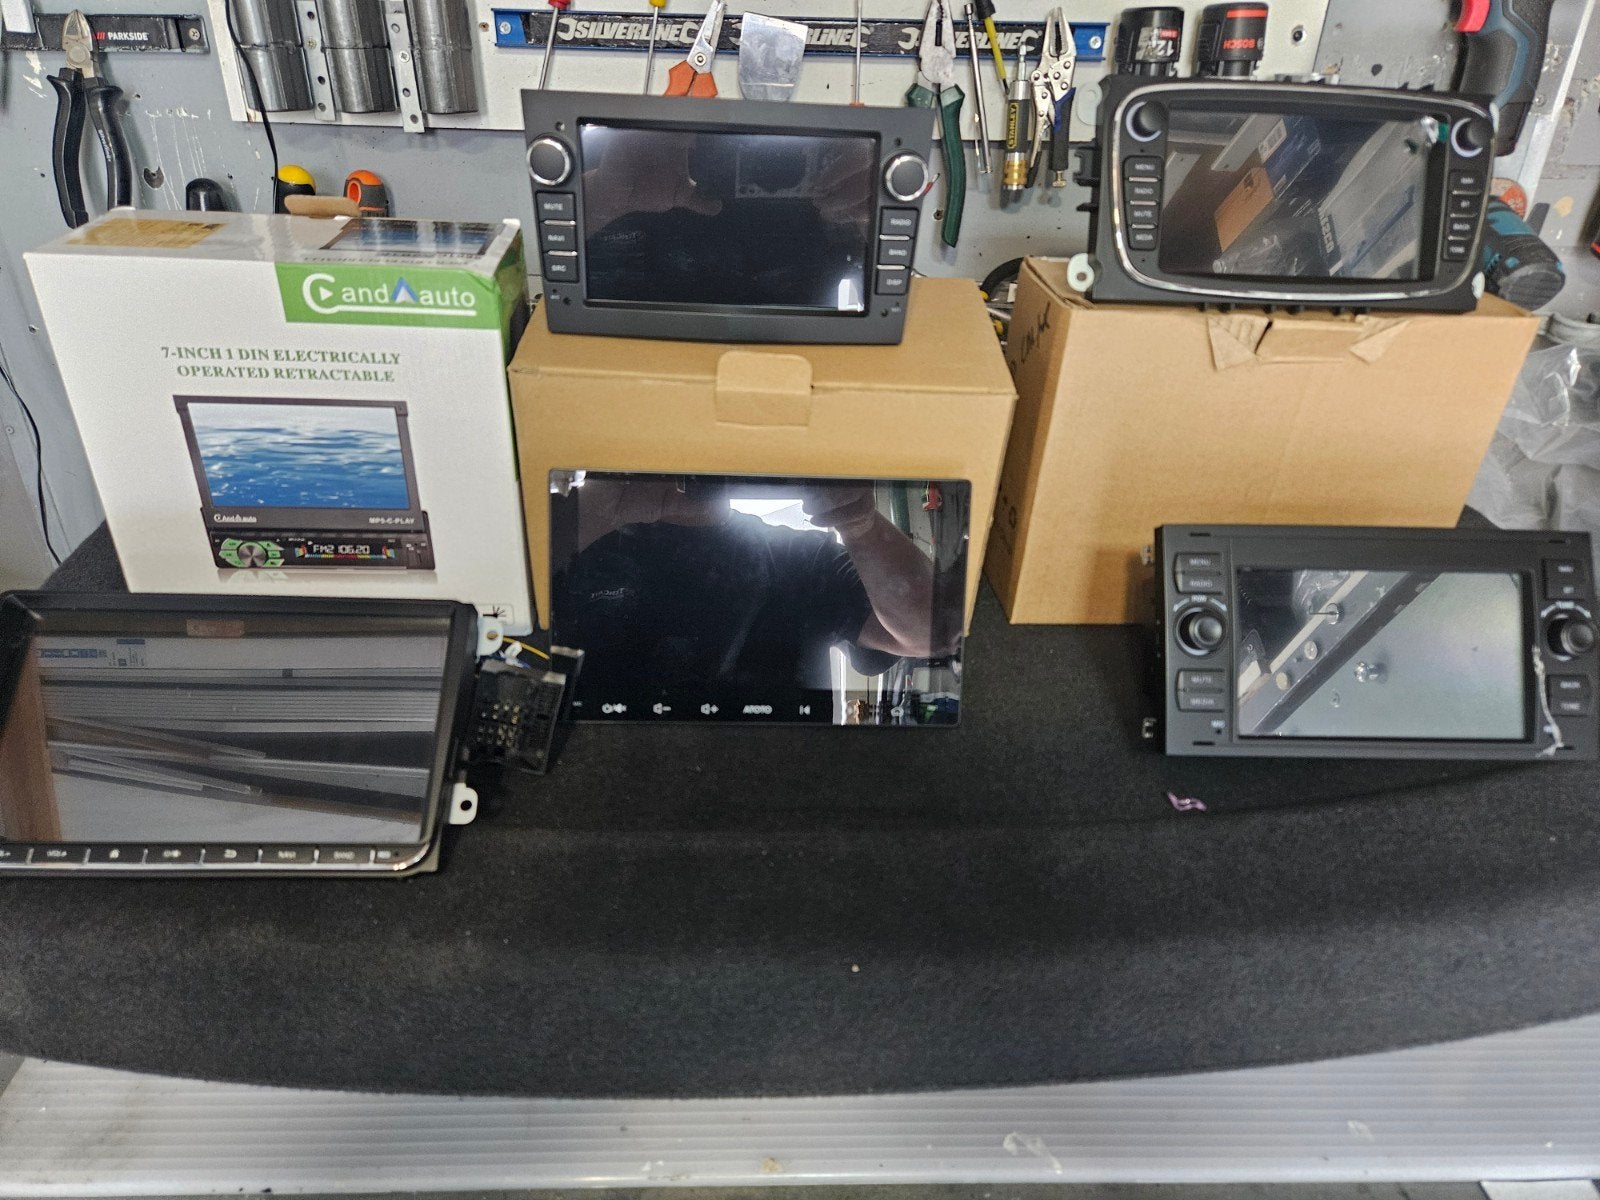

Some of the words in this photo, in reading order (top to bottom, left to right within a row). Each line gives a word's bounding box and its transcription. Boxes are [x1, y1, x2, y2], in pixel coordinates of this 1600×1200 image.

[107, 32, 148, 40] PARKSIDE
[1224, 38, 1256, 49] BOSCH
[161, 346, 221, 359] 7-INCH
[238, 348, 269, 361] DIN
[273, 349, 400, 365] ELECTRICALLY
[177, 365, 270, 378] OPERATED
[274, 367, 395, 383] RETRACTABLE
